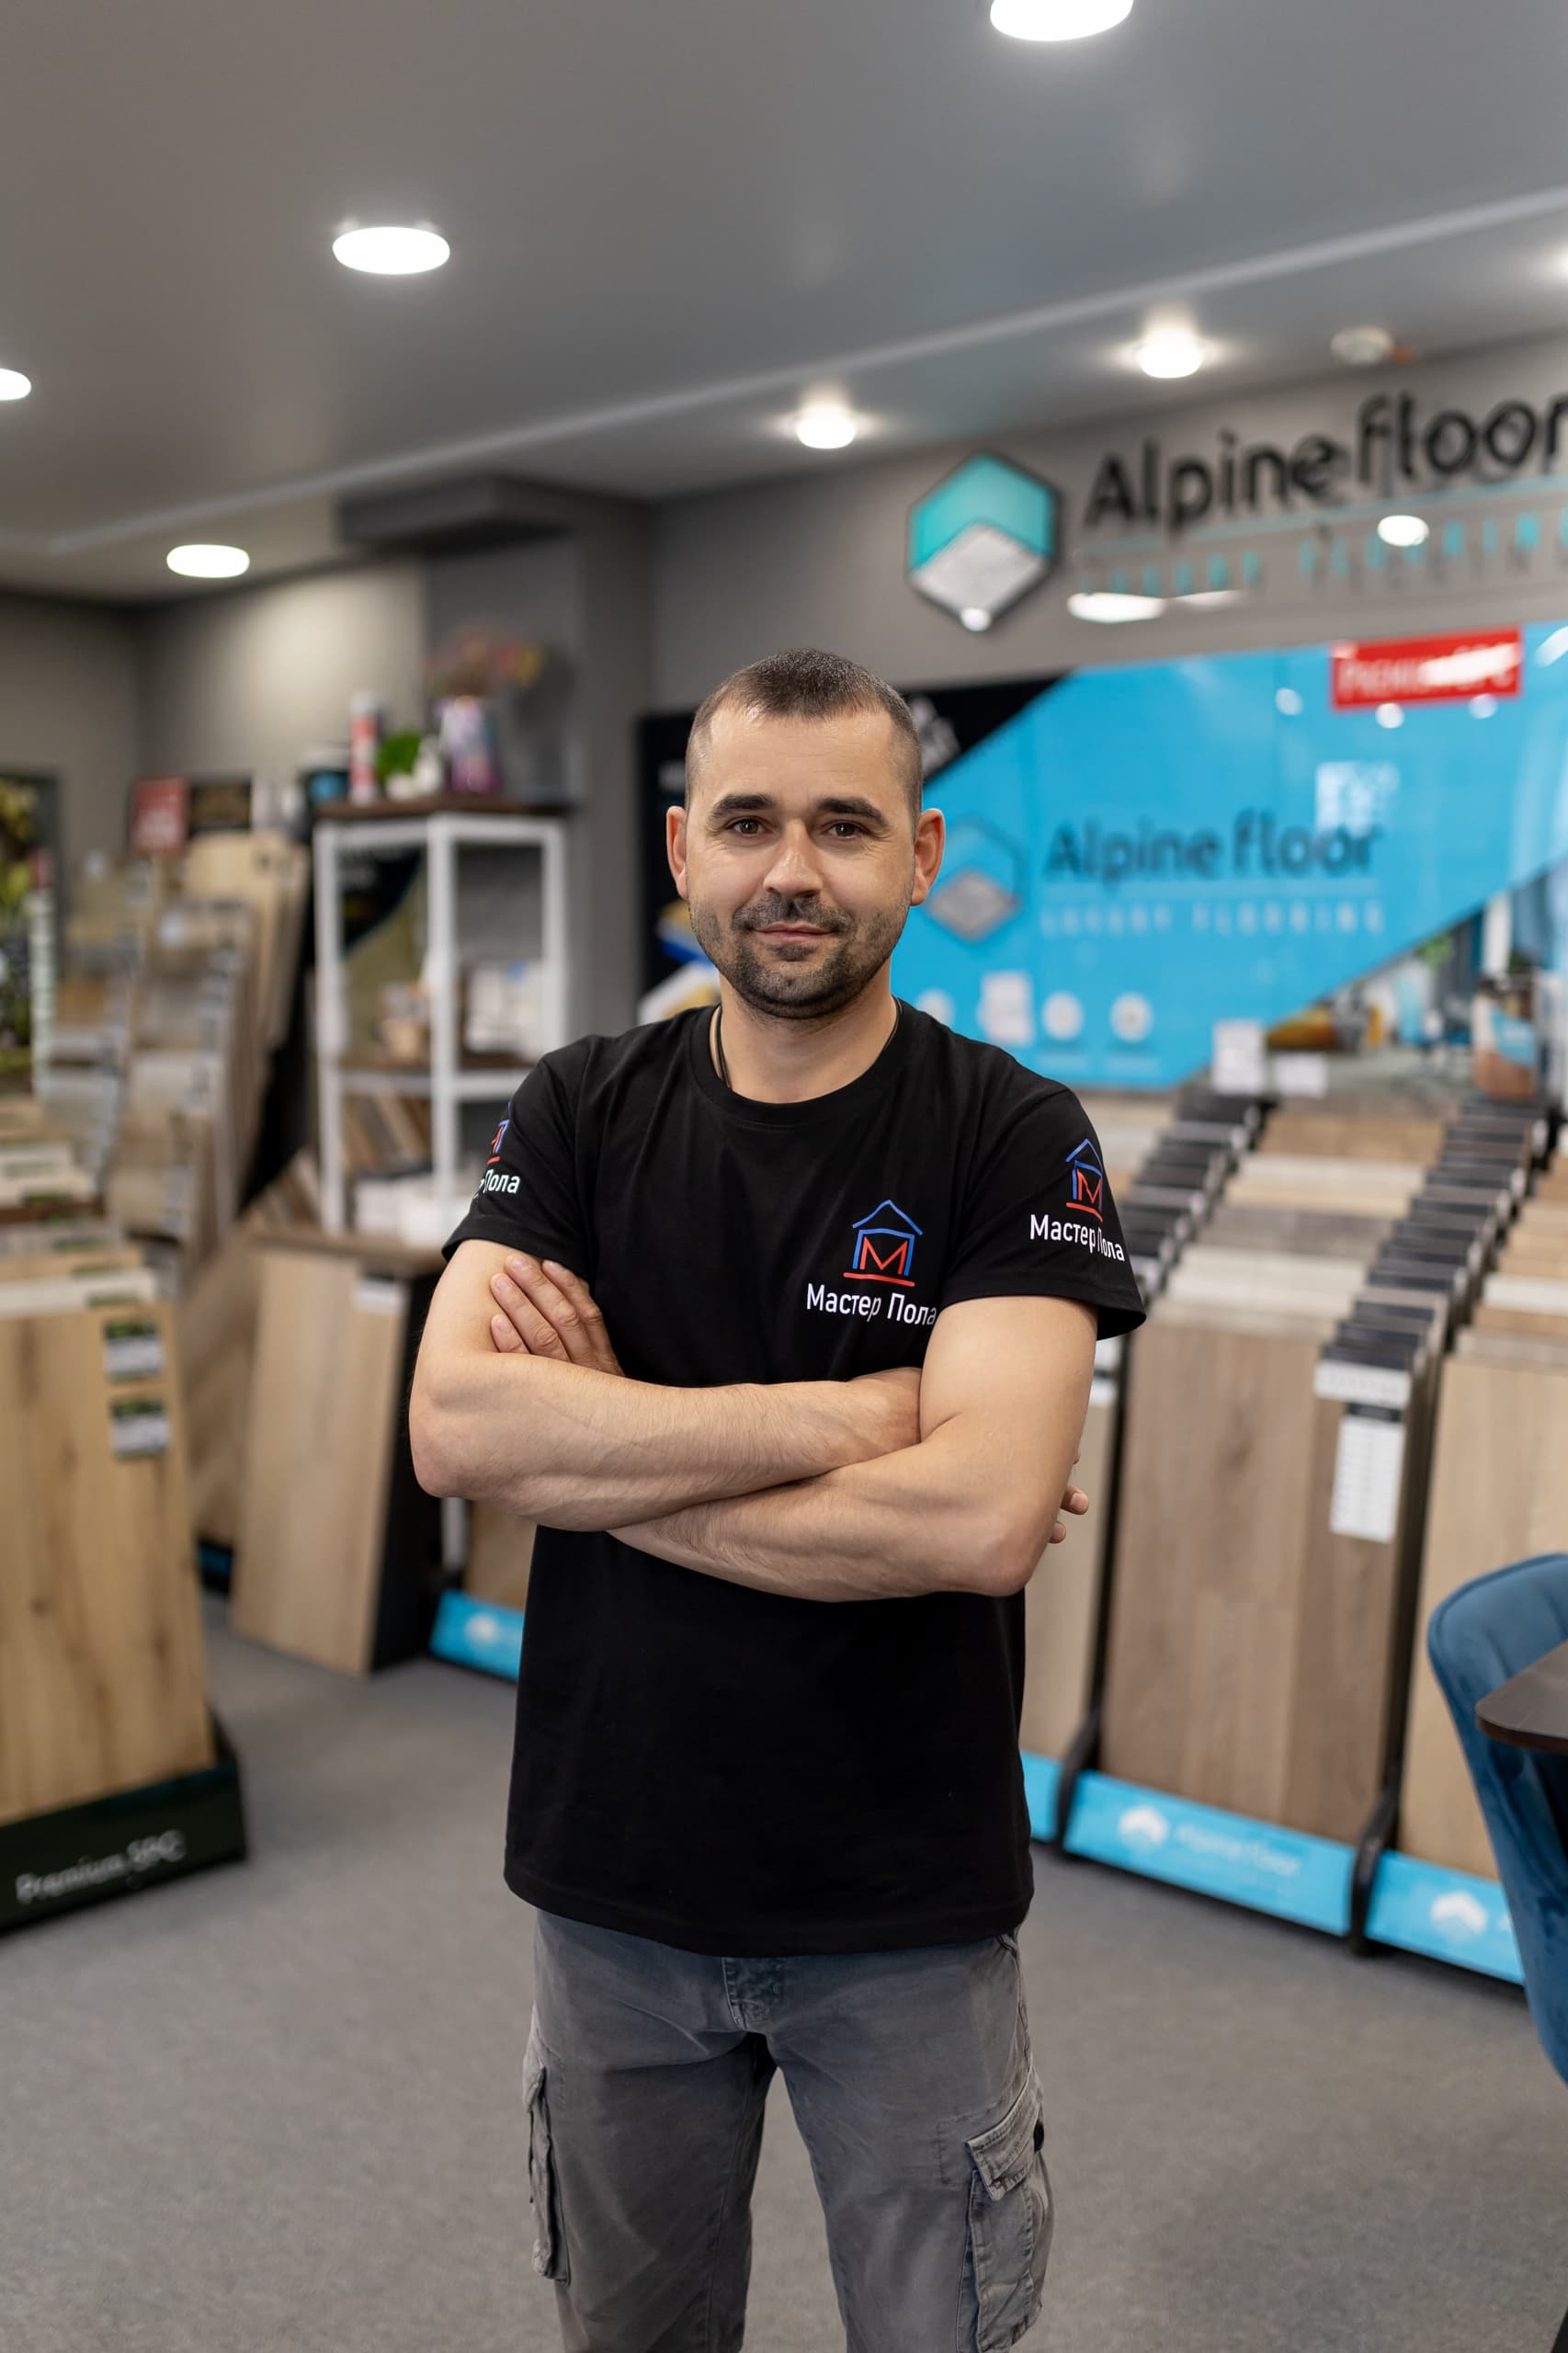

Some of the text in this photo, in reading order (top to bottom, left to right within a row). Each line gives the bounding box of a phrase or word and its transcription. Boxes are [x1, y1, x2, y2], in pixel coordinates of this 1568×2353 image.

[1083, 426, 1346, 541] Alpine
[1044, 816, 1221, 894] Alpine
[1029, 1214, 1096, 1254] Мастер
[806, 1283, 937, 1326] Мастер Пола
[16, 1856, 128, 1905] Premium
